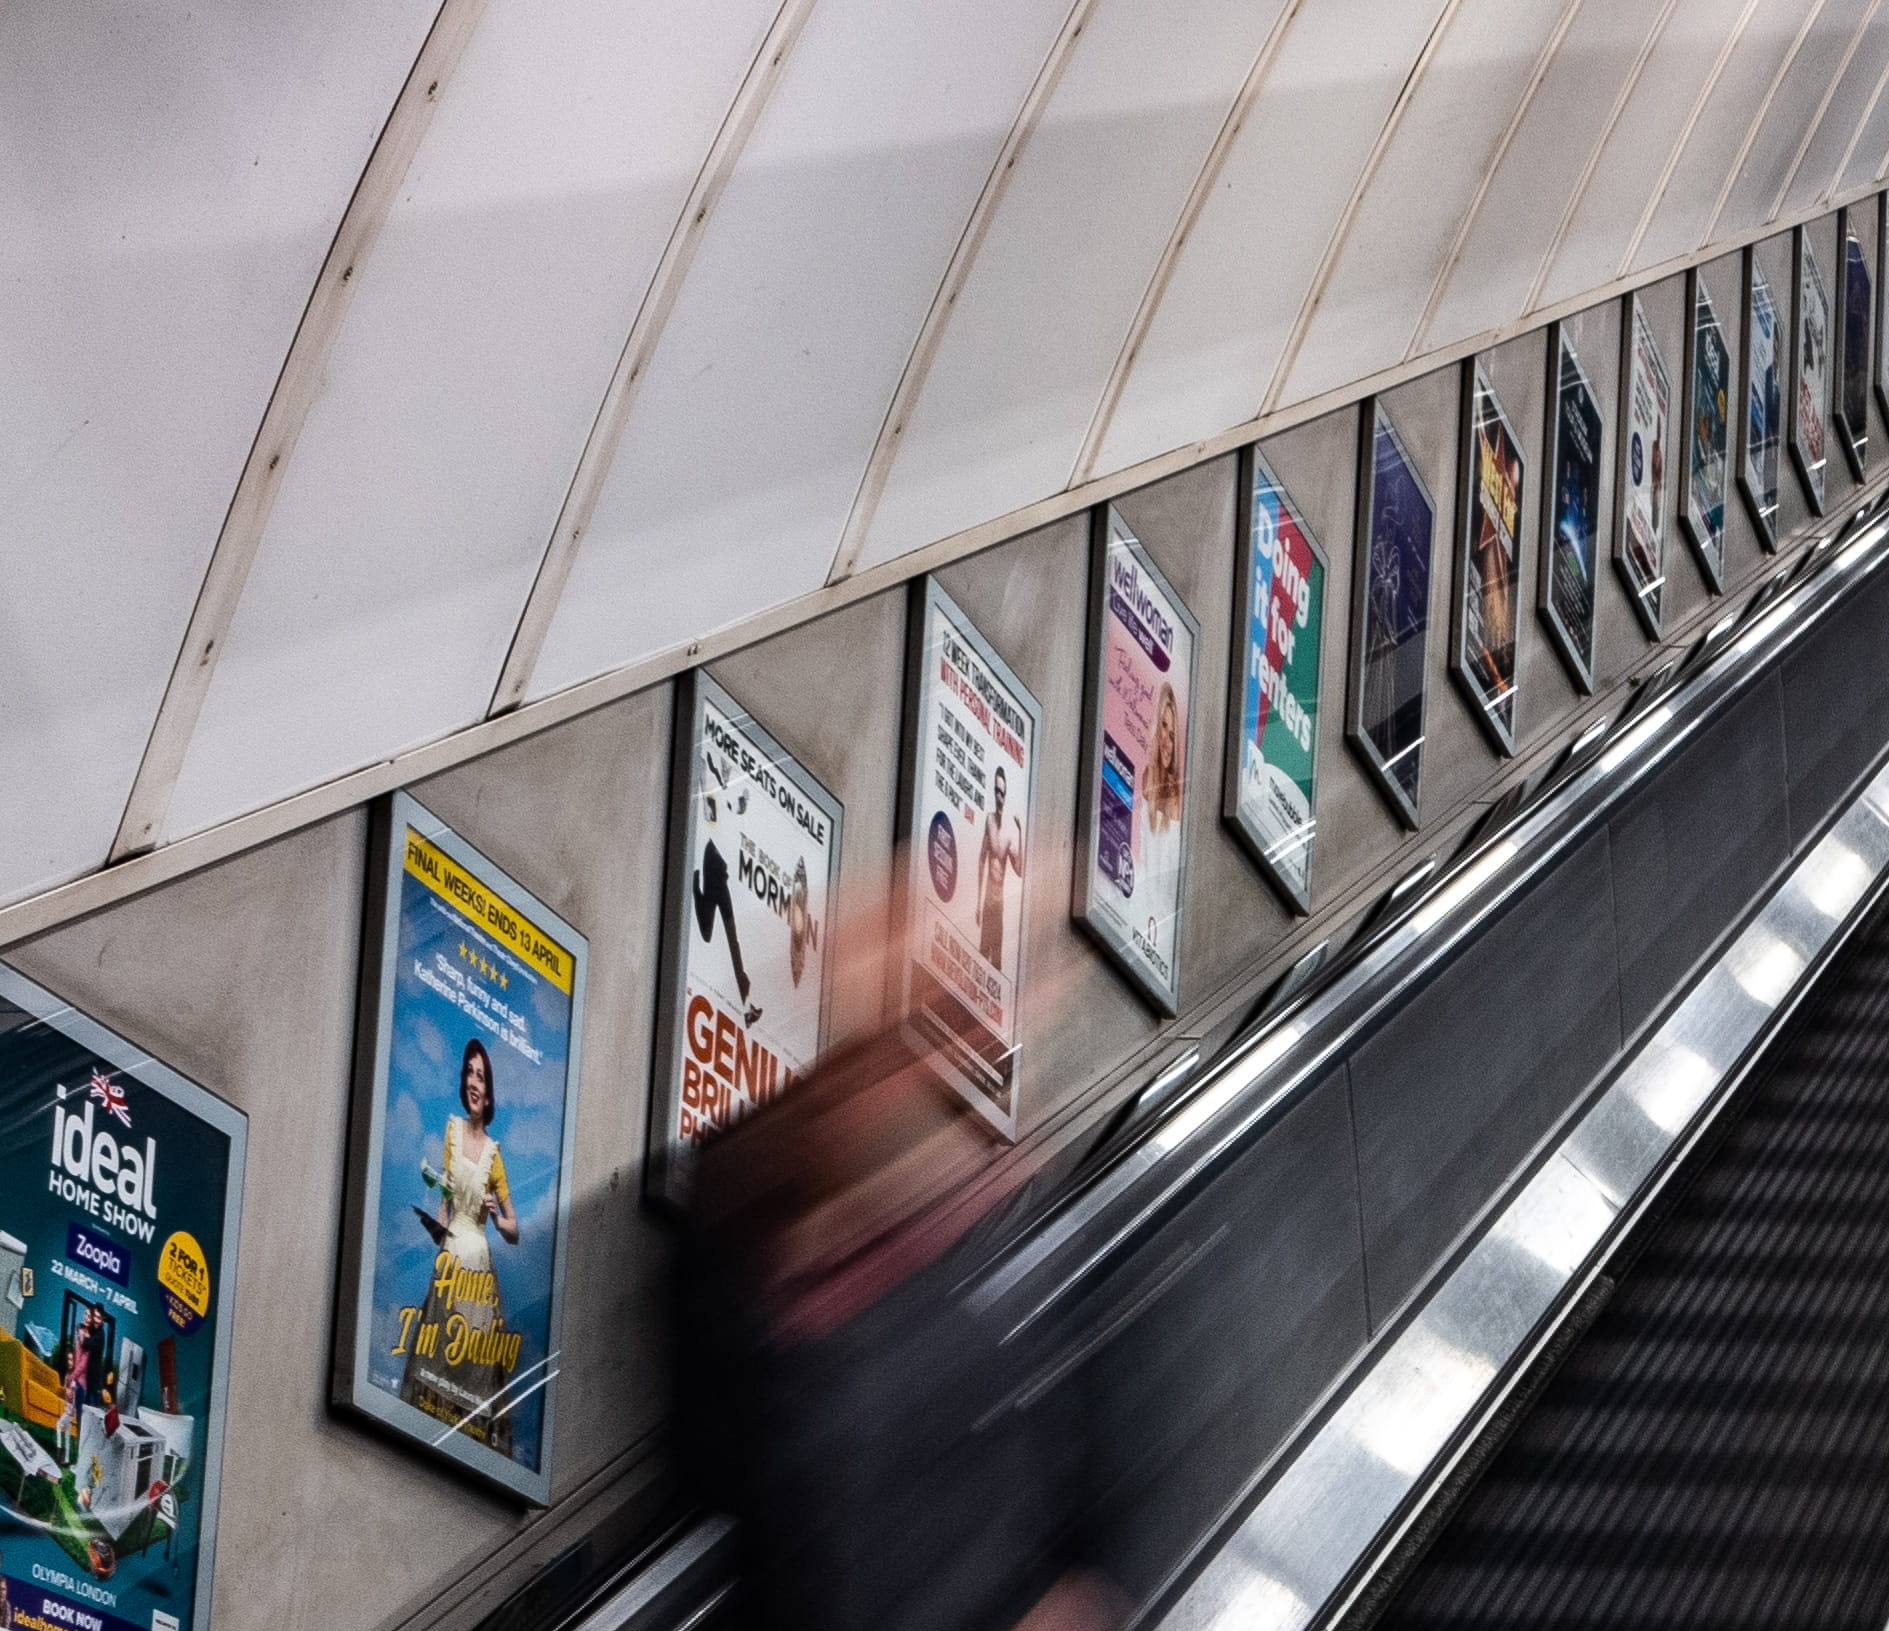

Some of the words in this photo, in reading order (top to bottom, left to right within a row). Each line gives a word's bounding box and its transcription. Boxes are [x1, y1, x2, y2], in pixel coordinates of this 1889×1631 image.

[1256, 502, 1310, 629] Doing
[1114, 556, 1174, 653] wellwoman
[1254, 564, 1269, 628] it
[1272, 594, 1296, 666] for
[1250, 646, 1312, 753] renters
[704, 713, 738, 764] MORE
[740, 752, 777, 799] SEATS
[778, 784, 796, 818] ON
[796, 801, 825, 847] SALE
[407, 842, 440, 883] FINAL
[443, 868, 485, 917] WEEKS!
[488, 901, 518, 941] ENDS
[519, 929, 530, 952] 13
[531, 941, 562, 978] APRIL
[490, 994, 508, 1020] and
[52, 1084, 157, 1220] ideal
[48, 1170, 100, 1216] HOME
[102, 1201, 156, 1244] SHOW
[66, 1265, 98, 1292] MARCH
[112, 1290, 138, 1314] APRIL
[77, 1234, 120, 1274] Zoopla
[170, 1242, 177, 1258] 2
[178, 1248, 198, 1276] FOR
[200, 1268, 205, 1281] 1
[434, 1250, 500, 1310] Home,
[391, 1305, 440, 1360] I'm
[445, 1312, 522, 1374] Darling
[32, 1563, 75, 1593] OLYMPIA
[76, 1578, 118, 1608] LONDON
[42, 1598, 76, 1624] BOOK
